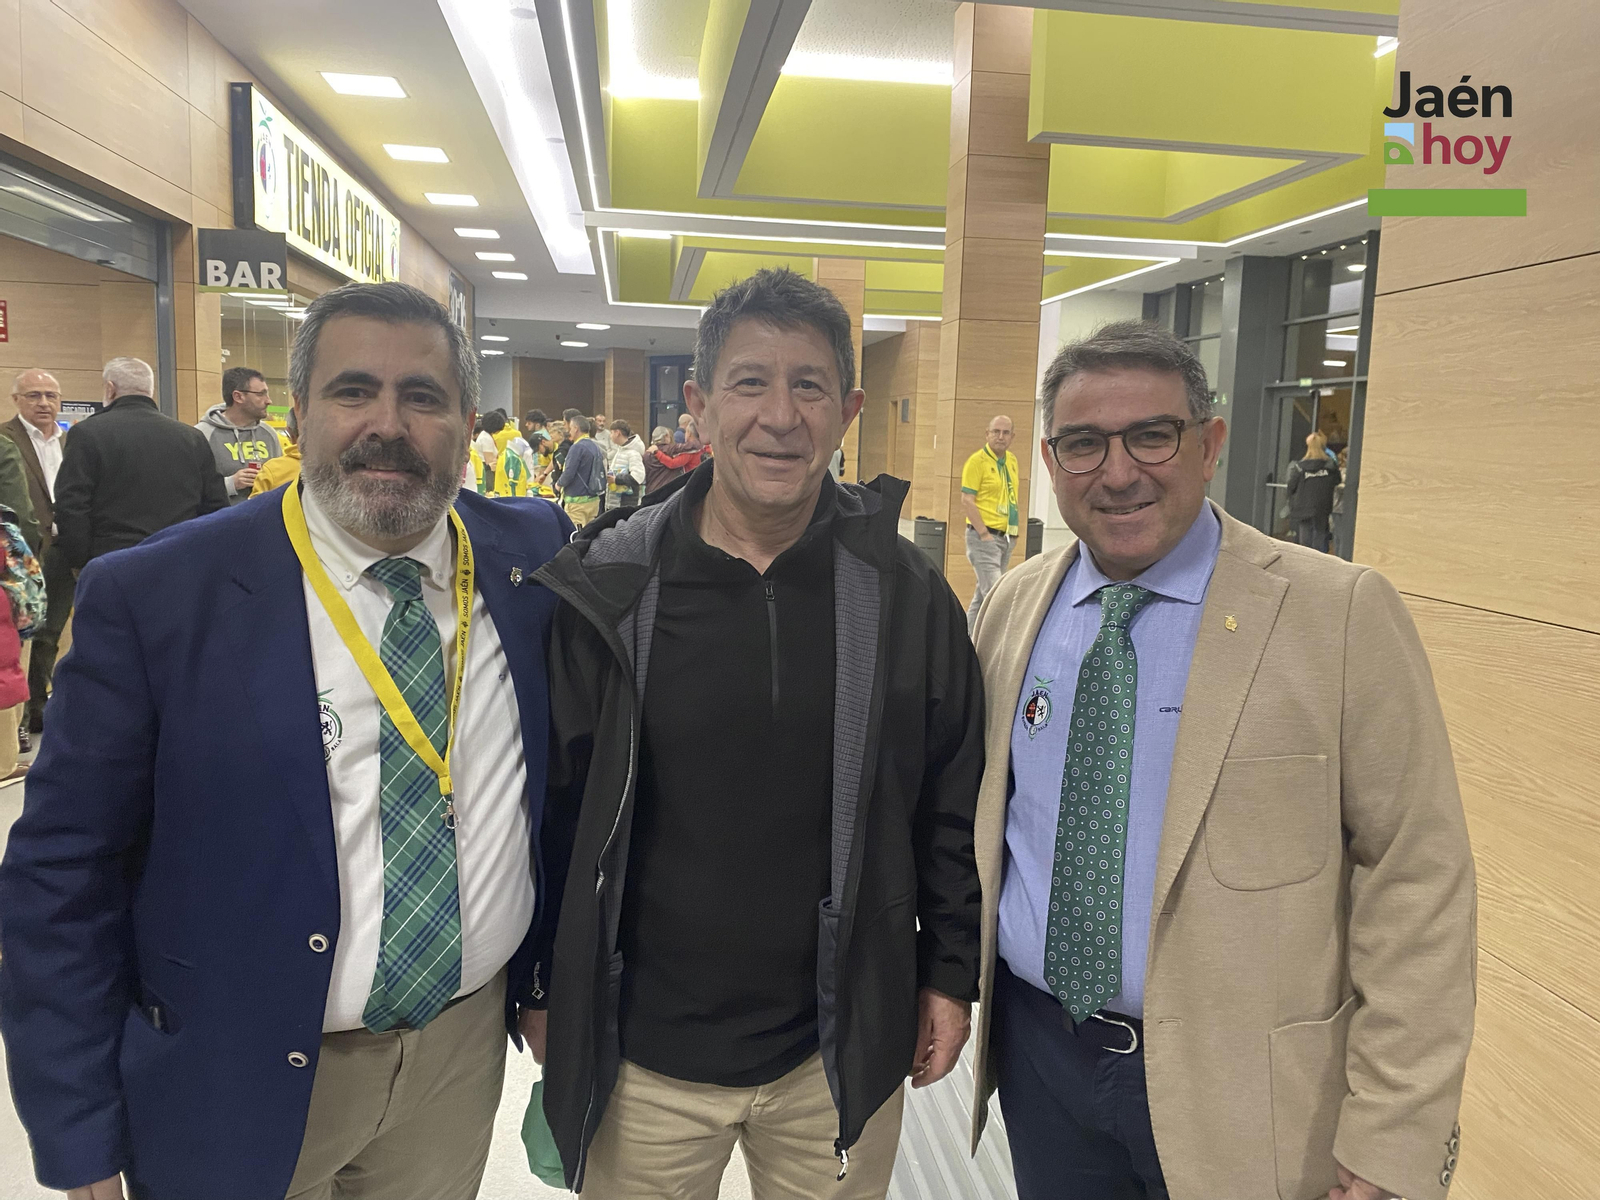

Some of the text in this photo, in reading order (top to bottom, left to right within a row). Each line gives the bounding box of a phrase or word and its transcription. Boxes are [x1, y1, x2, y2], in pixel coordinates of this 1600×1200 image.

[283, 133, 387, 284] TIENDA OFICIAL
[206, 259, 284, 289] BAR
[224, 440, 269, 461] YES
[462, 545, 470, 566] SOMOS
[460, 578, 469, 595] JAÉN
